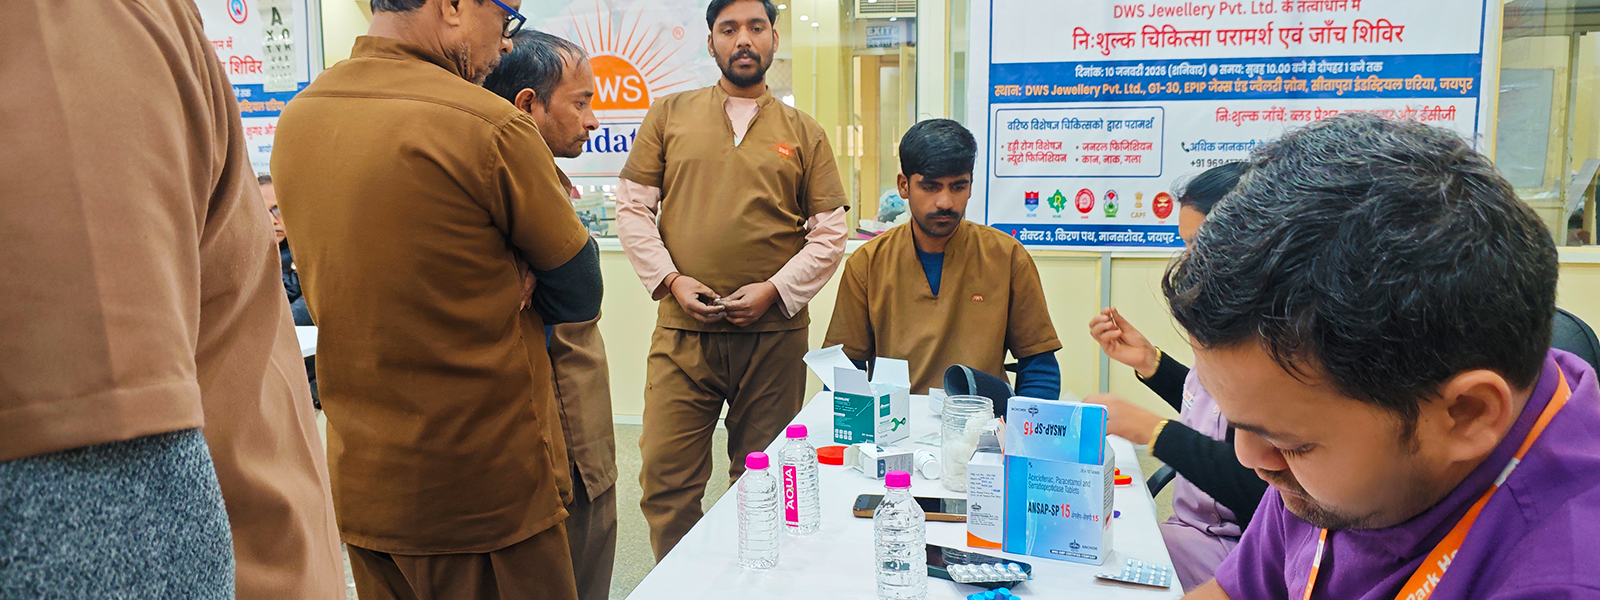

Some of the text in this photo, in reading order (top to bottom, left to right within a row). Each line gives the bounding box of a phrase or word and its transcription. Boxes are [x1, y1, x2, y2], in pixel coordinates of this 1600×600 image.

[271, 6, 283, 26] A
[1114, 4, 1145, 19] DWS
[1148, 2, 1215, 20] Jewellery
[1219, 1, 1246, 15] Pvt.
[1251, 0, 1277, 14] Ltd.
[1141, 24, 1212, 48] चिकित्सा
[1216, 21, 1275, 47] परामर्श
[1278, 21, 1303, 49] एवं
[1309, 19, 1347, 44] जाँच
[1353, 18, 1405, 44] शिविर
[229, 55, 263, 75] शिविर
[1105, 67, 1114, 77] 10
[1115, 65, 1144, 77] जनवरी
[1168, 64, 1207, 78] (शनिवार)
[1245, 63, 1265, 78] सुबह
[1266, 63, 1291, 74] 10.00
[1292, 61, 1307, 74] बजे
[1317, 61, 1343, 74] दोपहर
[1349, 60, 1365, 73] बजे
[1366, 61, 1383, 73] तक
[594, 75, 642, 103] WS
[1025, 84, 1049, 96] DWS
[1051, 83, 1101, 98] Jewellery
[1102, 83, 1122, 95] Pvt.
[1184, 81, 1206, 93] EPIP
[1311, 75, 1353, 96] सीतापुरा
[1439, 77, 1474, 95] जयपुर
[1289, 109, 1311, 122] ब्लड
[1420, 104, 1456, 122] ईसीजी
[1020, 139, 1034, 151] रोग
[1190, 139, 1216, 152] अधिक
[1023, 421, 1067, 437] ANSAP-SP 15
[785, 468, 795, 510] AQUA
[1028, 481, 1080, 495] Serratiopeptidase Tablets
[1056, 476, 1082, 486] Paracetamol
[1082, 480, 1091, 488] and
[1028, 501, 1060, 517] ANSAP-SP
[1060, 503, 1071, 518] 15
[1092, 514, 1099, 522] 15
[1405, 572, 1440, 600] Park
